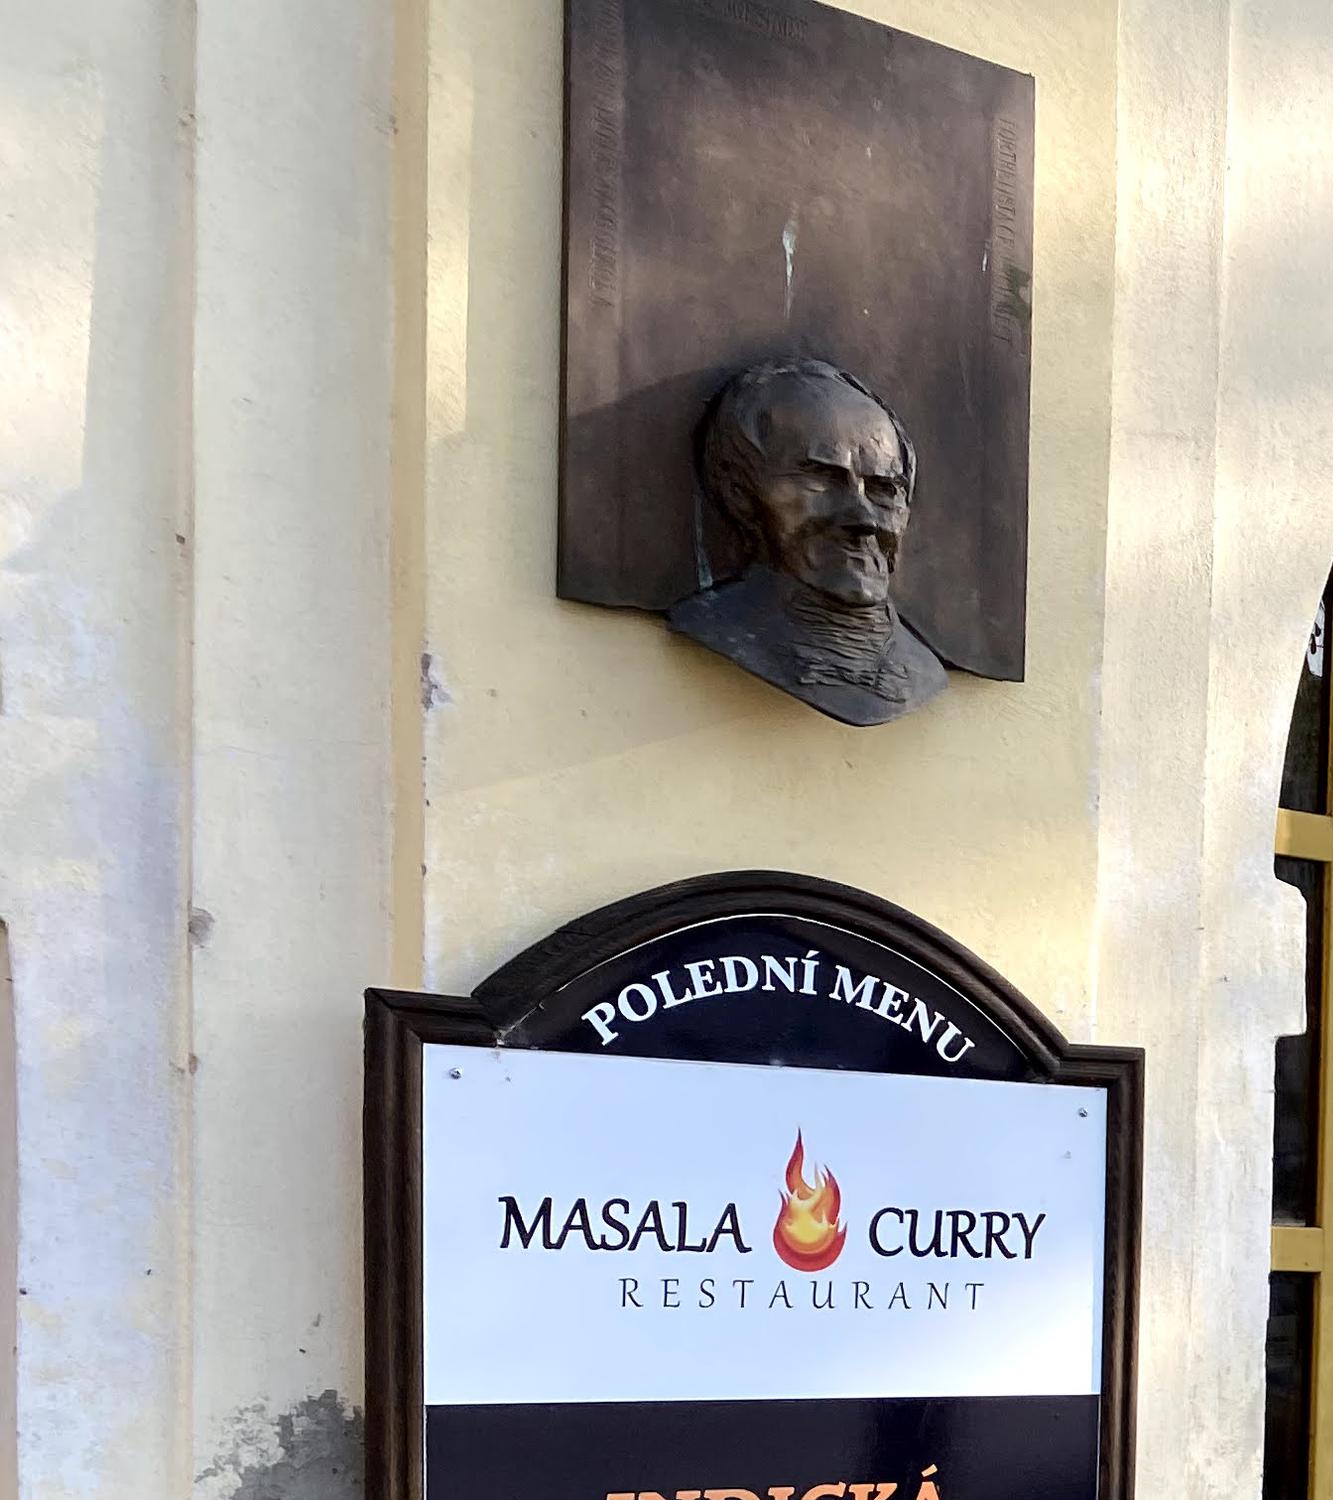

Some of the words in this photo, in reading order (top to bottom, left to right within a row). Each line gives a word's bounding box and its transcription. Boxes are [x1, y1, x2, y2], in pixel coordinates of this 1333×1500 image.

[581, 950, 821, 1046] POLEDNÍ
[829, 964, 976, 1063] MENU
[497, 1195, 753, 1255] MASALA
[868, 1206, 1047, 1261] CURRY
[618, 1277, 985, 1311] RESTAURANT
